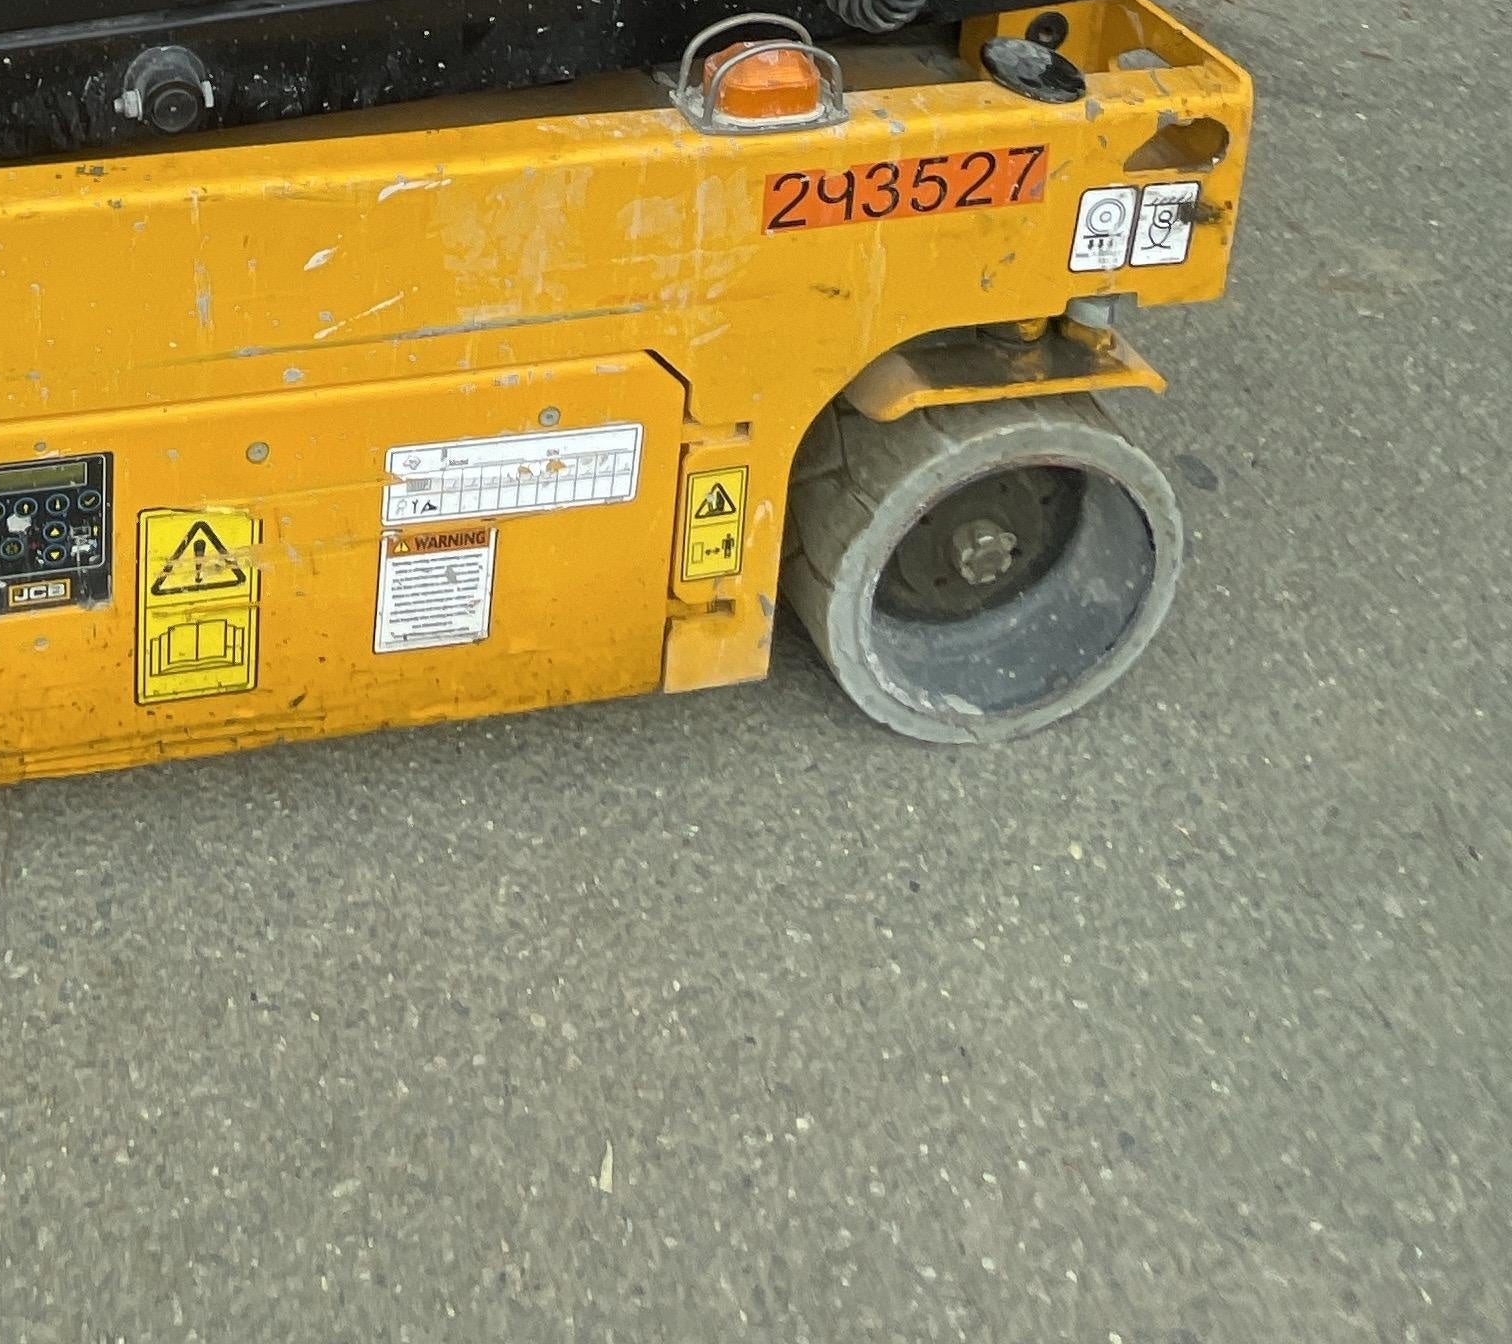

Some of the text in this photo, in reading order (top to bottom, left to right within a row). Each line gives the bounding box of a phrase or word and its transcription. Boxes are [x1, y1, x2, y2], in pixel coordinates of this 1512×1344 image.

[767, 145, 1046, 230] 293527
[414, 530, 486, 551] WARNING
[14, 583, 66, 602] JCB
